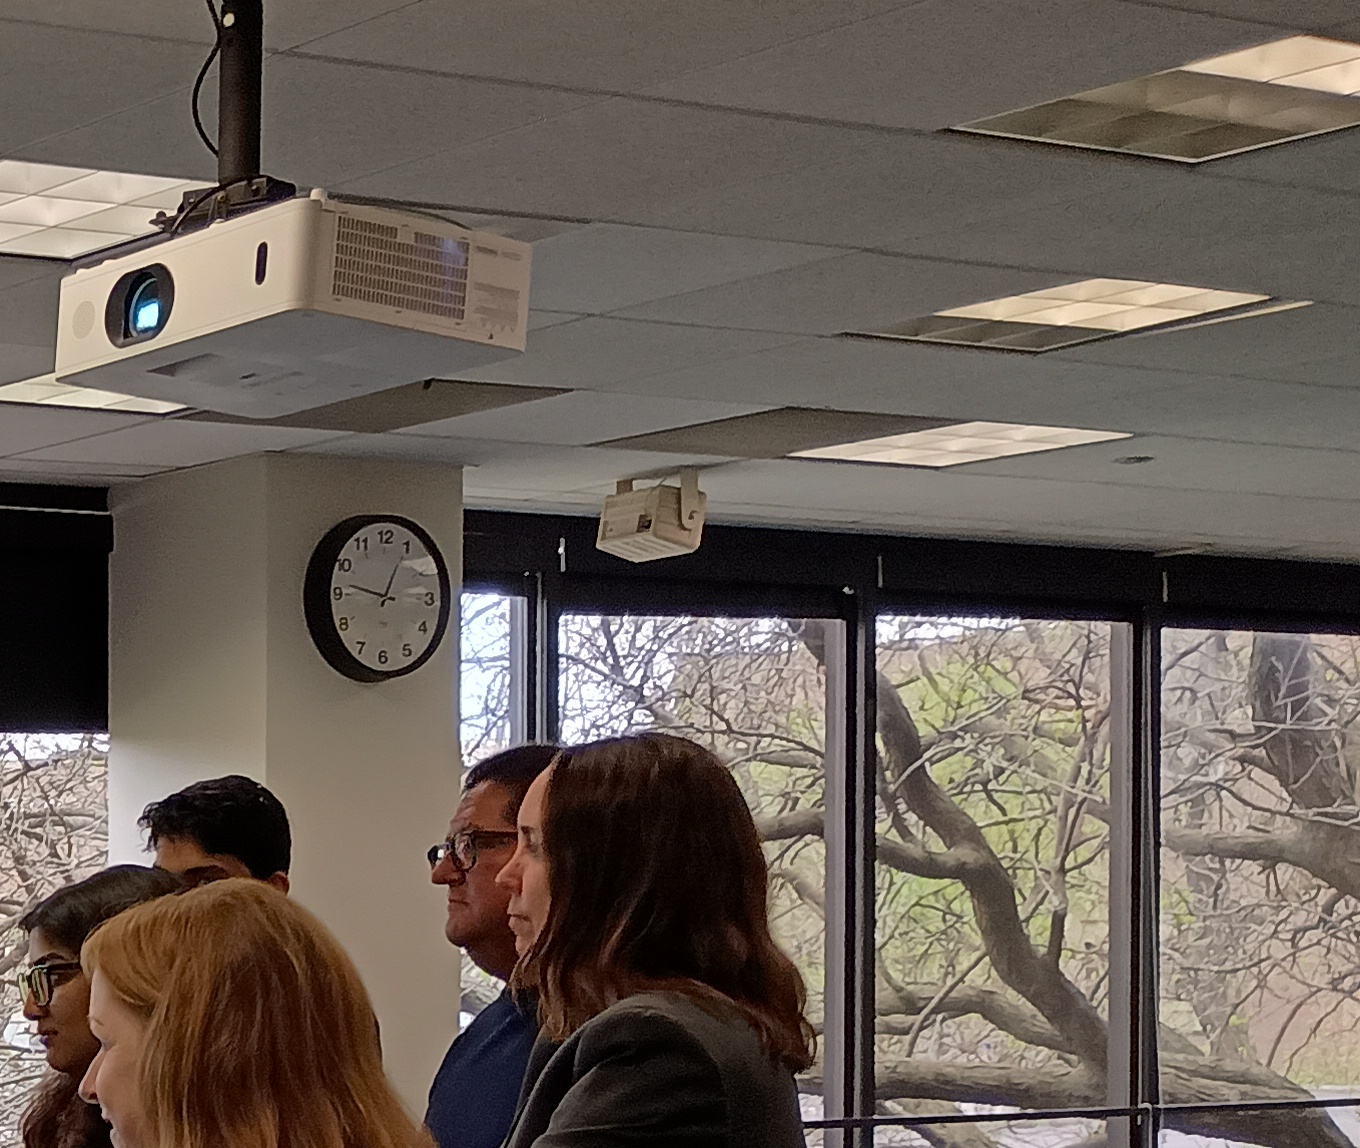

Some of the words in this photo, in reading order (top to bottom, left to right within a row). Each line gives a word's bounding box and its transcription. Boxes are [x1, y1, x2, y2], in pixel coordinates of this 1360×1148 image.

[377, 529, 394, 544] 12
[354, 537, 369, 551] 11
[402, 540, 411, 554] 1
[336, 558, 352, 572] 10
[333, 586, 343, 600] 9
[424, 592, 435, 606] 3
[339, 617, 349, 631] 8
[418, 620, 428, 635] 4
[356, 641, 366, 655] 7
[402, 643, 412, 657] 5
[378, 650, 388, 664] 6
